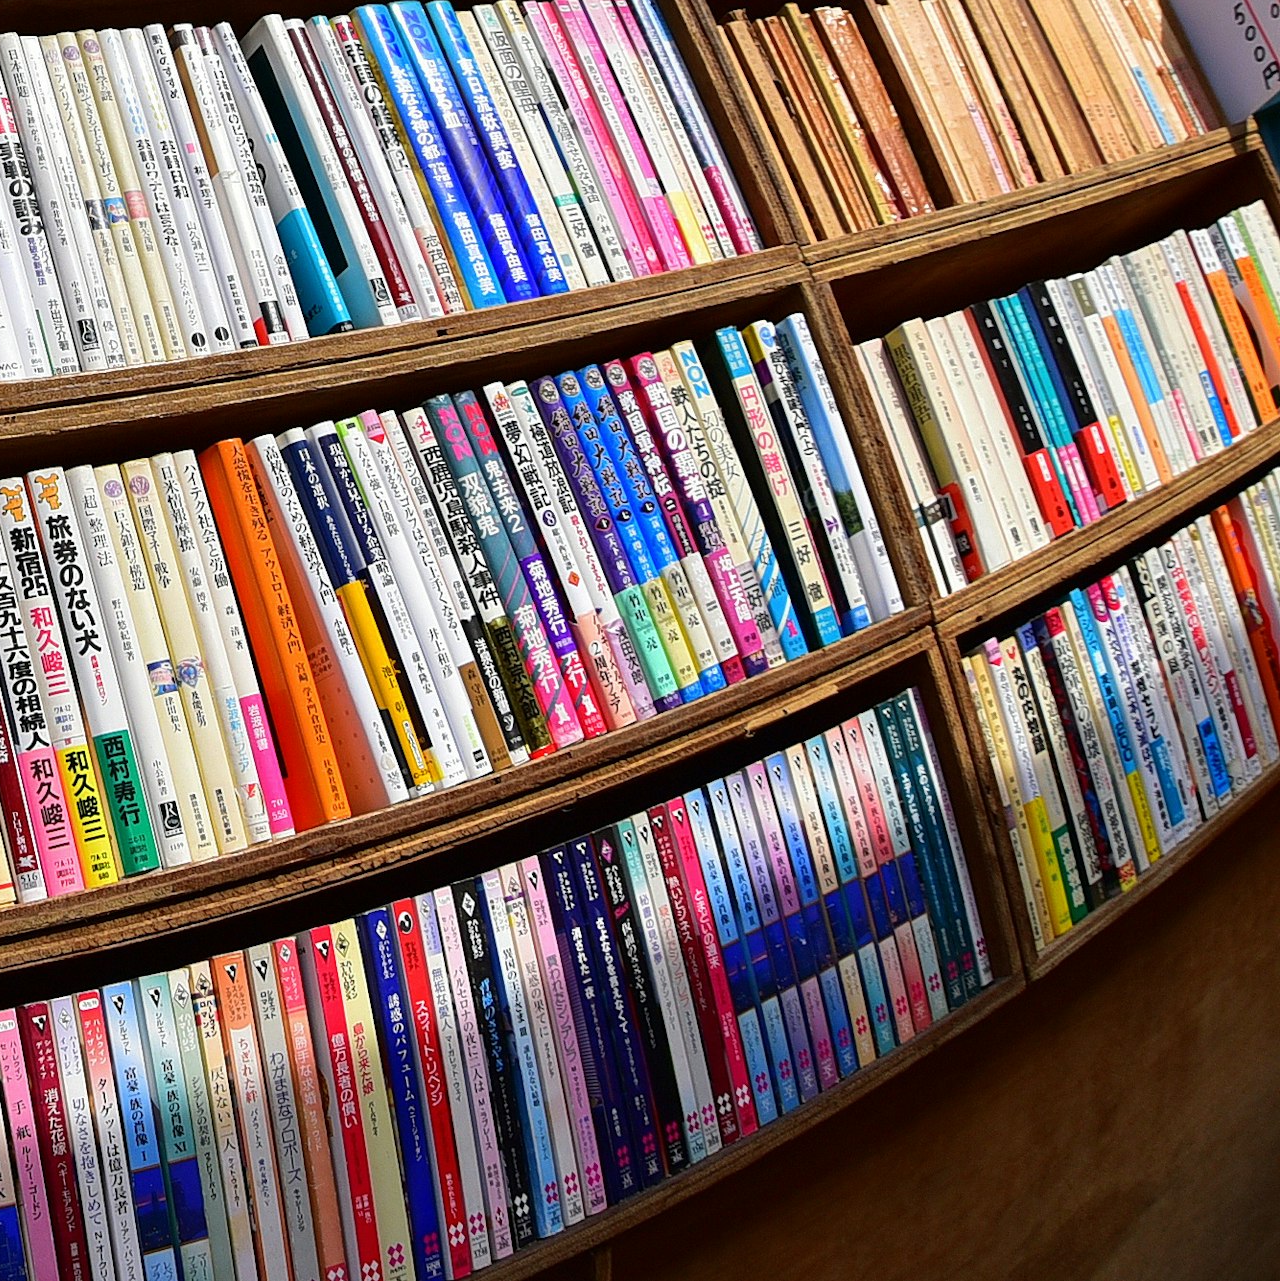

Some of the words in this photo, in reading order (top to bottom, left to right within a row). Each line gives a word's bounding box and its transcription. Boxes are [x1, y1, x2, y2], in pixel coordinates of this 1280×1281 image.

[456, 58, 515, 169] 東日流妖異変
[493, 31, 538, 115] 仮面の聖母
[160, 141, 189, 198] 英語日和
[423, 234, 461, 304] 志茂田景樹
[669, 387, 727, 498] 鉄人たちの掟
[740, 385, 789, 497] 円形の賭け
[231, 445, 269, 542] 大恐慌を生き残る
[420, 447, 500, 610] 西鹿児島駅殺人事件
[46, 515, 102, 655] 旅券のない犬
[525, 560, 566, 635] 菊地秀行
[494, 623, 539, 719] 西村京太郎
[29, 759, 70, 849] 和久峻三
[103, 738, 140, 826] 西村寿行
[237, 1038, 258, 1104] ちぎれた絆
[330, 1034, 358, 1129] 億万長者の償い
[416, 1000, 443, 1107] スウィート・リベンジ
[44, 1088, 67, 1156] 消えた花嫁
[97, 1078, 128, 1213] ターゲットは億万長者
[270, 1052, 301, 1182] わがままなプロポーズ
